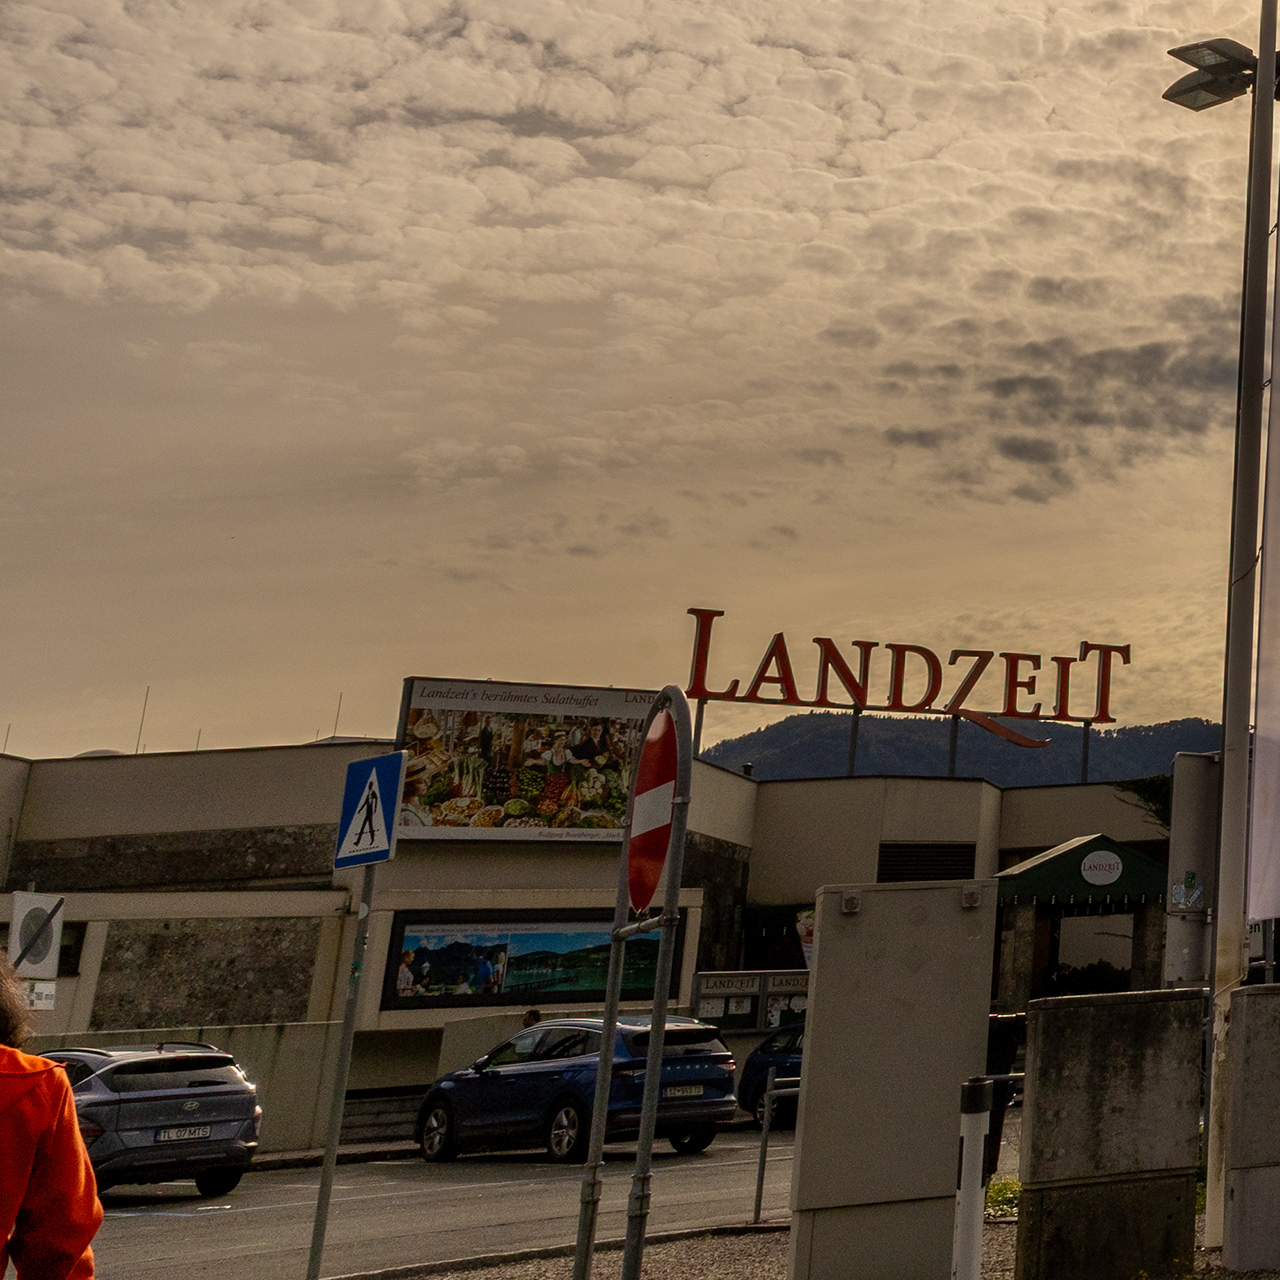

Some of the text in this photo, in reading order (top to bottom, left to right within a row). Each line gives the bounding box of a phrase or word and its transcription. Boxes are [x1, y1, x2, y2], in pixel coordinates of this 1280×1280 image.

[685, 607, 1131, 749] LANDZEIT
[481, 691, 538, 704] berühmtes
[541, 693, 599, 708] Salatbuffet
[624, 692, 656, 705] LAND
[1083, 862, 1121, 874] LANDZEIT
[705, 977, 757, 991] LANDZEIT
[772, 976, 809, 988] LANDZE
[162, 1130, 173, 1139] TL
